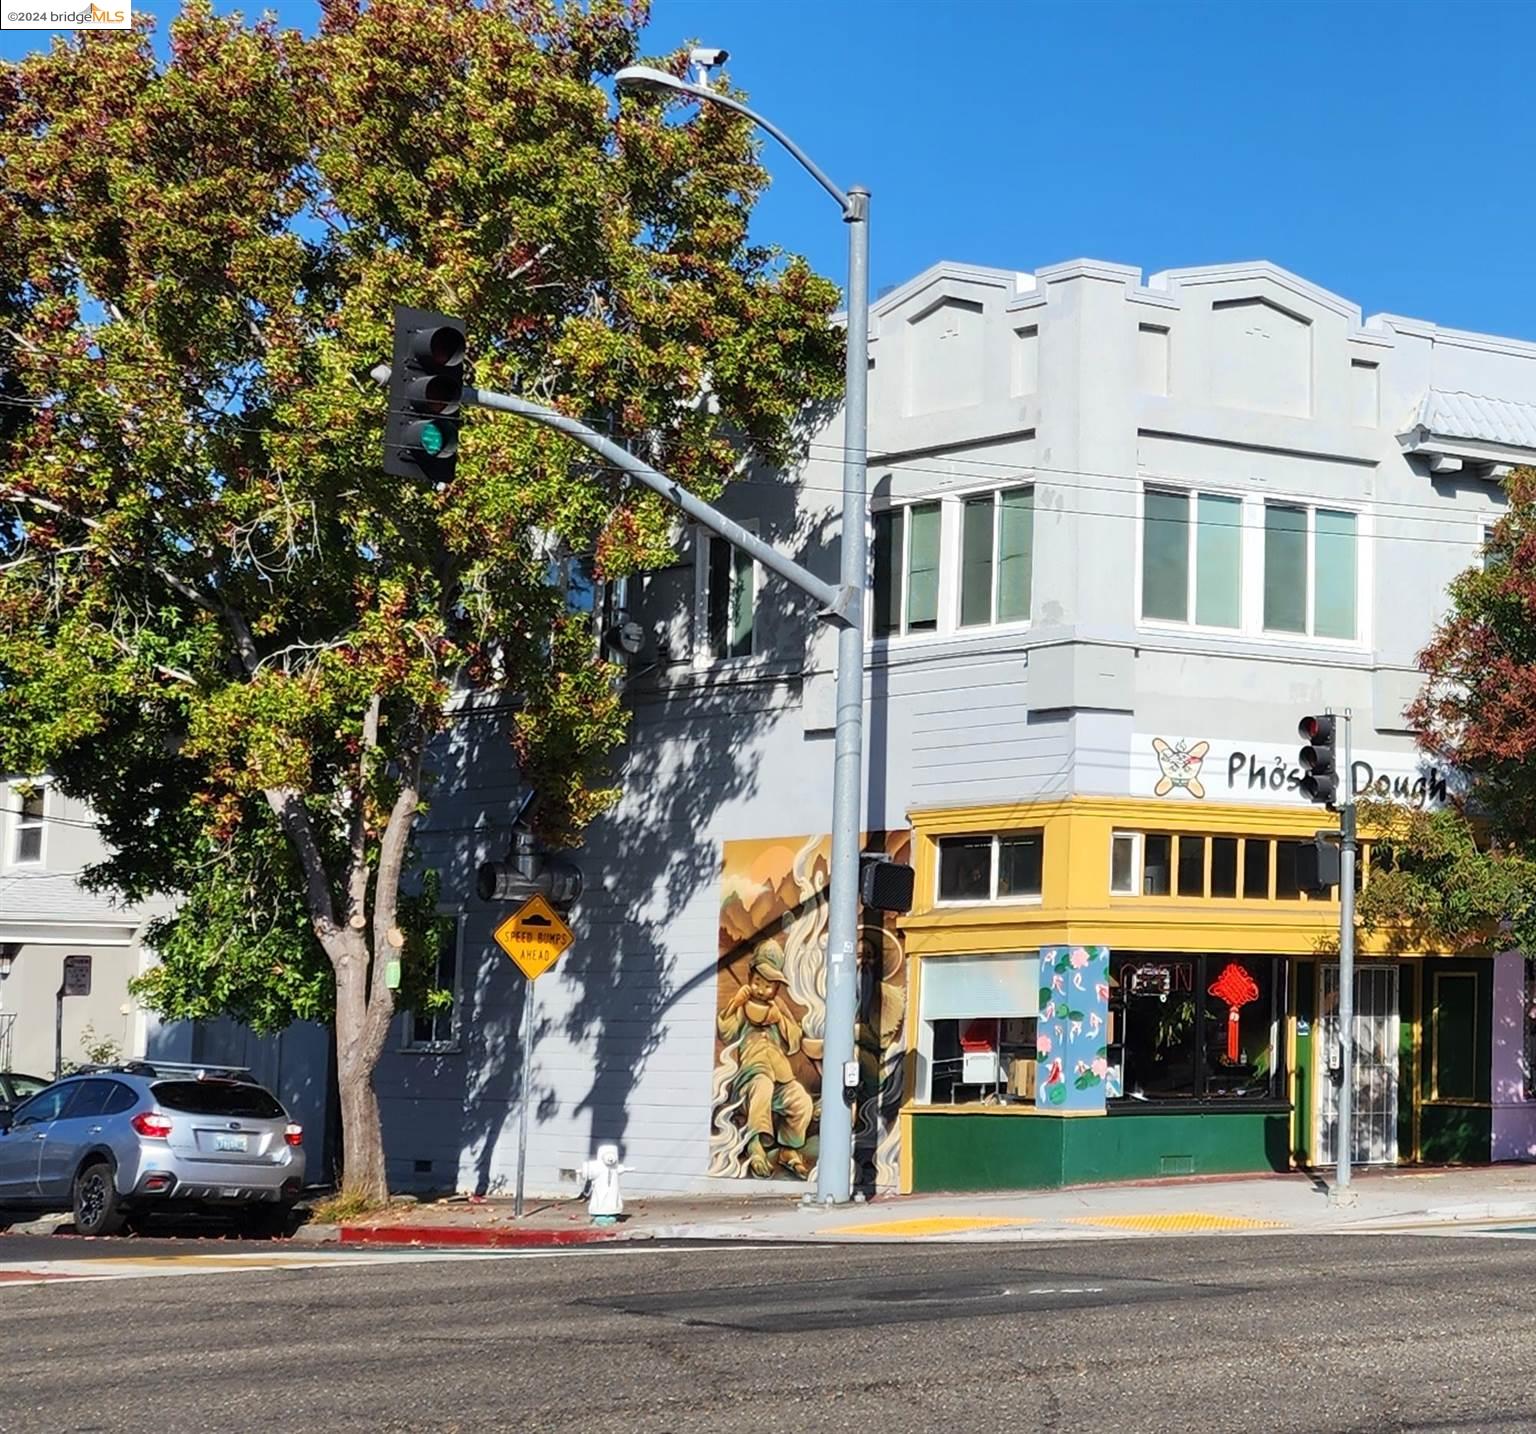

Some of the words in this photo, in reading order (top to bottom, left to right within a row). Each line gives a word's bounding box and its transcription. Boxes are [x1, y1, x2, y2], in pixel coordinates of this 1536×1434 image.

[1351, 761, 1446, 810] Dough
[504, 931, 532, 943] SPEED
[538, 932, 567, 945] BUMPS
[521, 949, 549, 961] AHEAD
